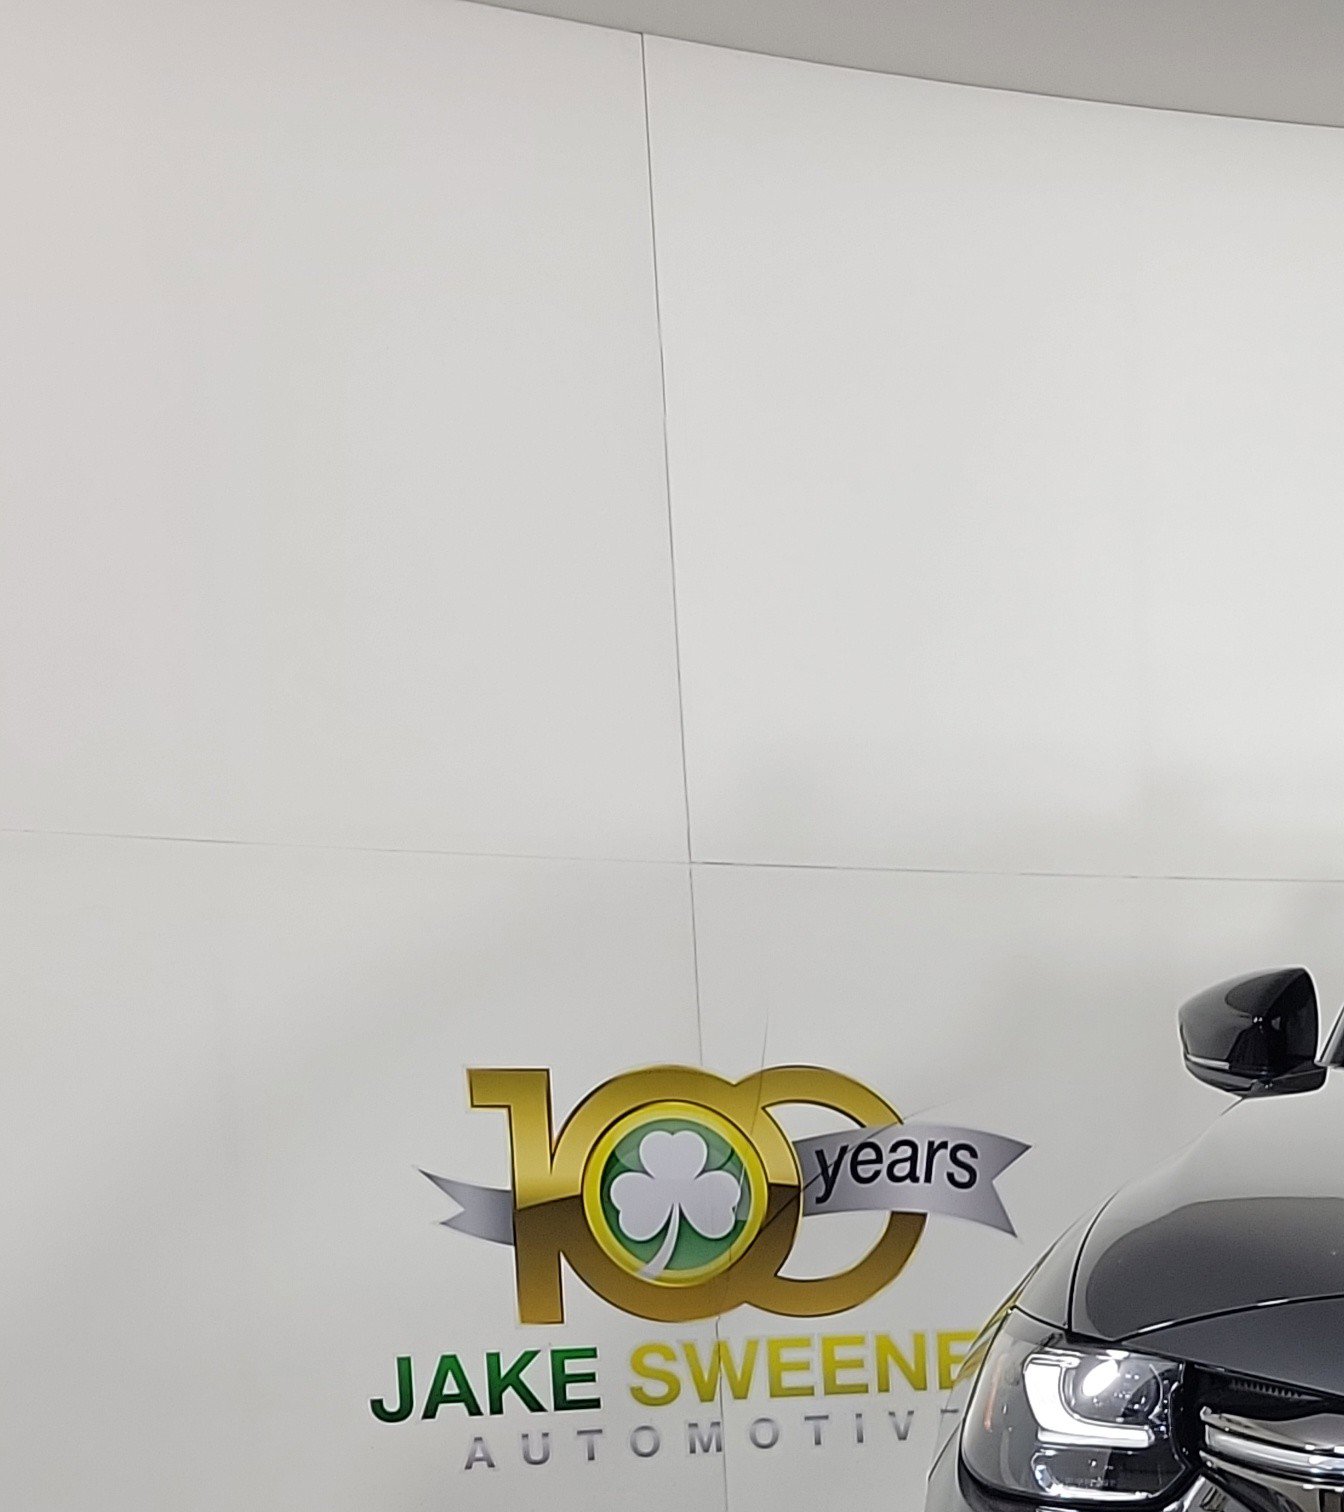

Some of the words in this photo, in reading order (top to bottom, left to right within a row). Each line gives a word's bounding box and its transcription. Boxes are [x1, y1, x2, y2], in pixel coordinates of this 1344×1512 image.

[466, 1064, 929, 1325] 100
[814, 1137, 979, 1203] years
[370, 1346, 602, 1424] JAKE
[628, 1330, 979, 1408] SWEENE
[463, 1409, 959, 1471] AUTOMOTIV
